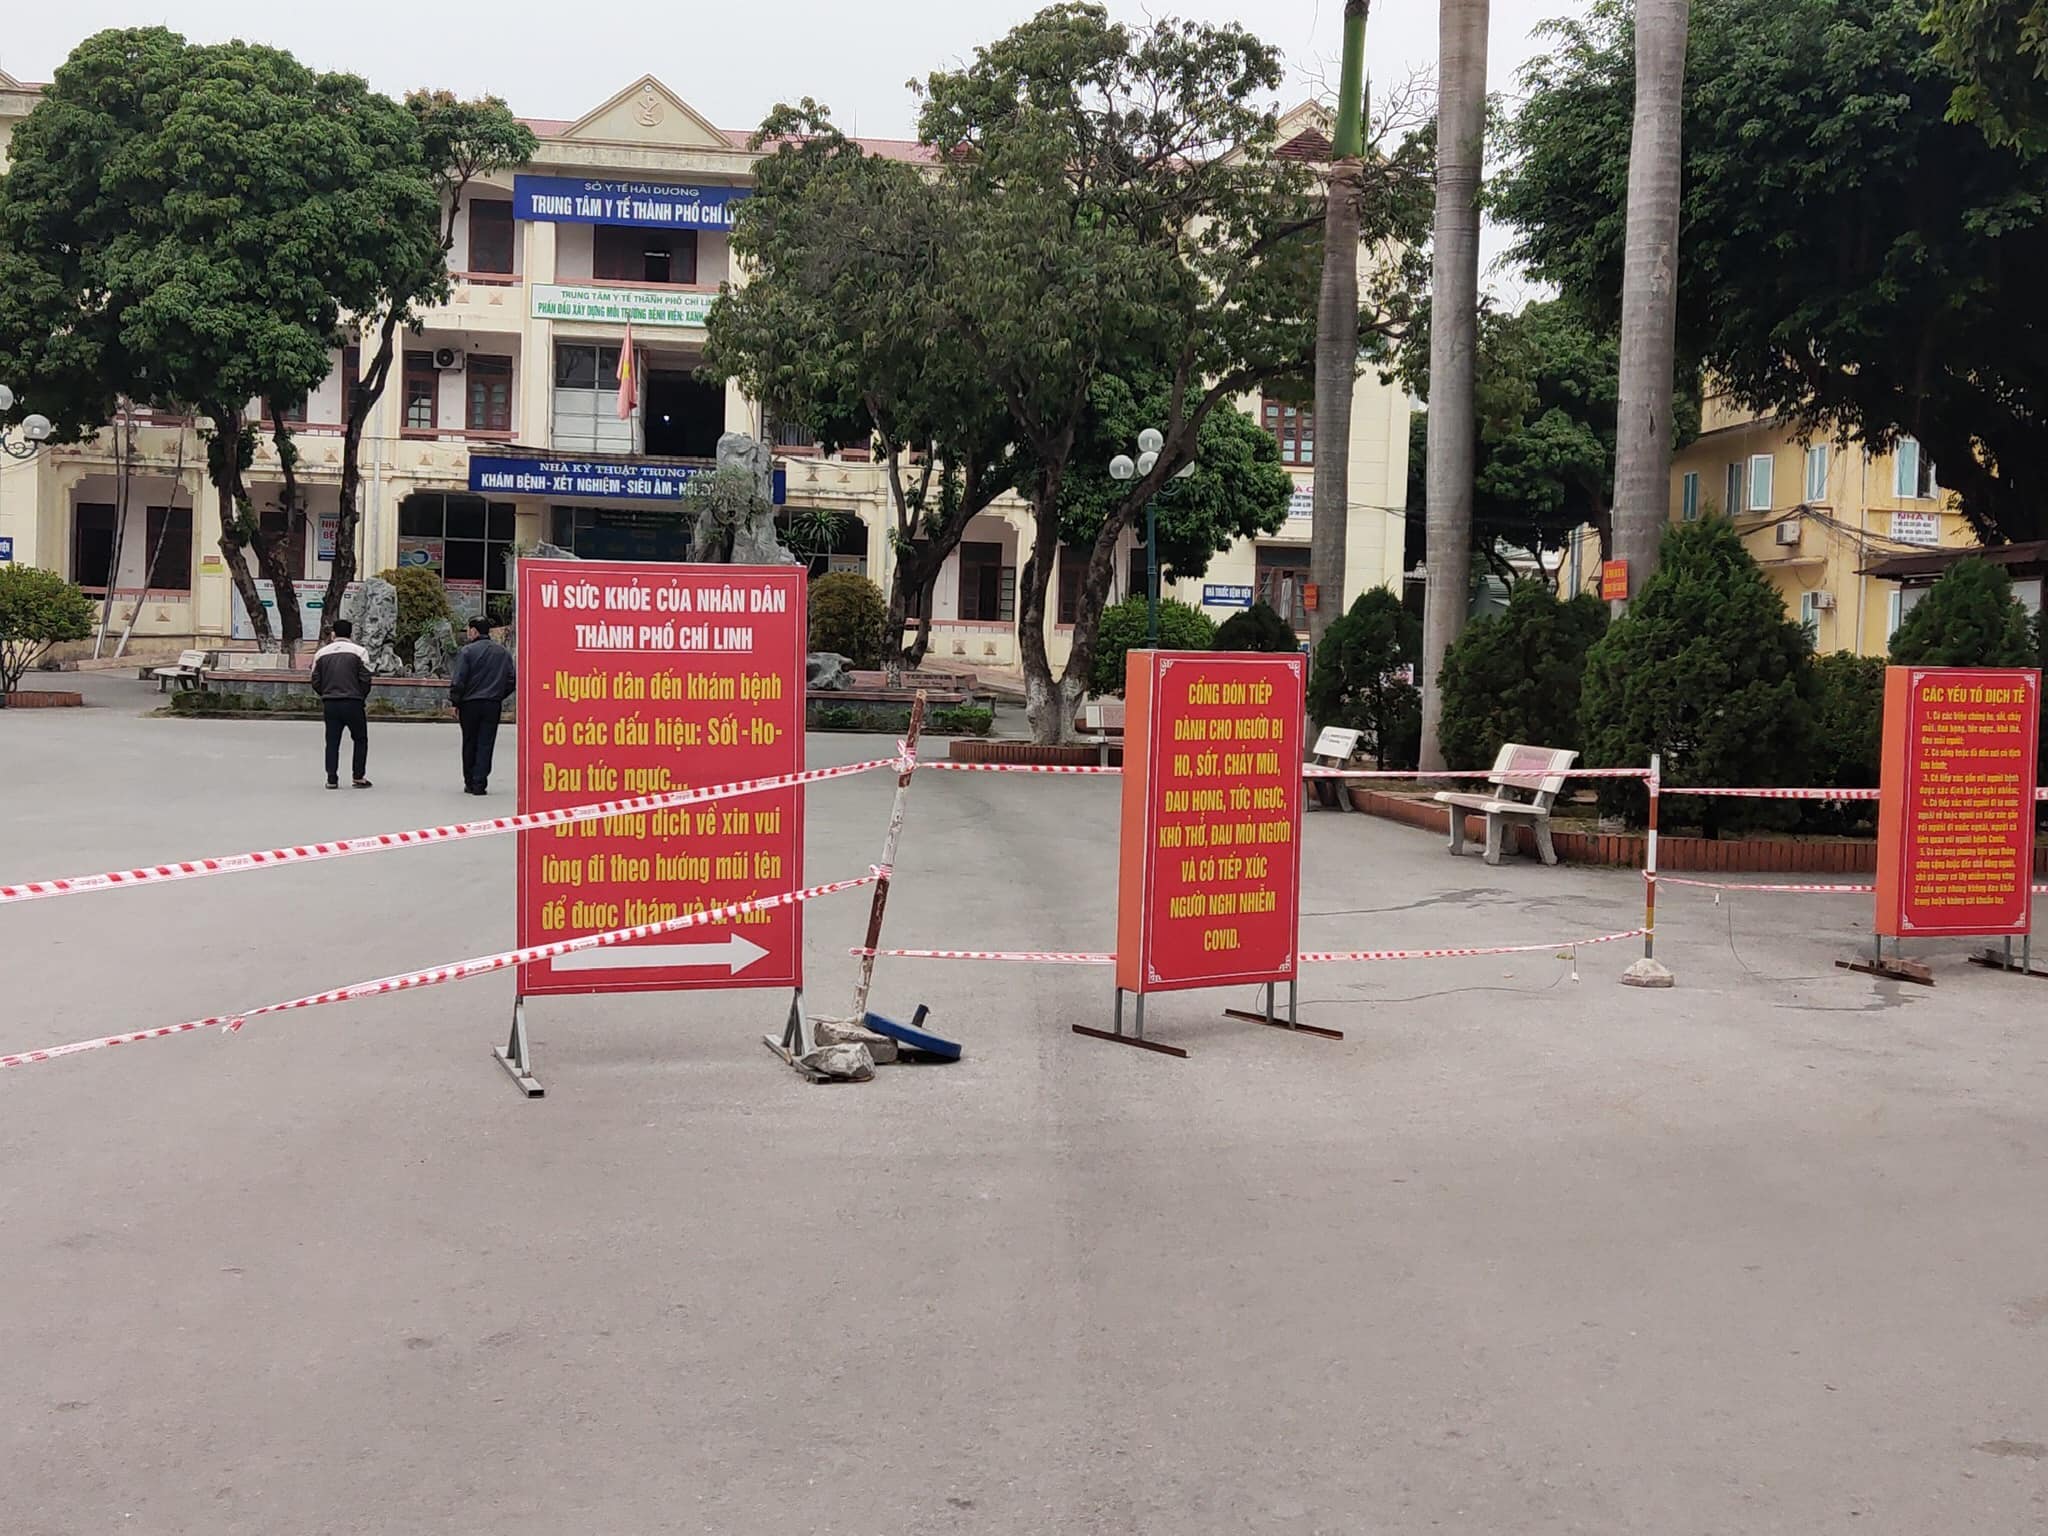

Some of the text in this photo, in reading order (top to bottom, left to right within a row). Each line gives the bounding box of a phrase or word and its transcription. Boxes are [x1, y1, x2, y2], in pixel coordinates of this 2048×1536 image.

[585, 181, 700, 197] SỞ Y TẾ HẢI DƯƠNG
[531, 194, 747, 225] TRUNG TÂM Y TẾ THÀNH PHỐ CHÍ LI
[561, 291, 590, 300] TRUNG
[592, 290, 611, 301] TÂM
[613, 294, 621, 302] Y
[622, 292, 632, 303] TẾ
[634, 294, 663, 305] THÀNH
[664, 295, 682, 305] PHỐ
[481, 471, 514, 489] KHÁM
[516, 473, 546, 491] BỆNH
[553, 474, 573, 491] XÉT
[576, 476, 620, 495] NGHIỆM
[627, 478, 652, 495] SIÊU
[654, 478, 672, 496] ÂM
[540, 462, 570, 473] NHÀ
[572, 463, 592, 474] KỸ
[595, 464, 638, 477] THUẬT
[641, 467, 686, 478] TRUNG
[541, 577, 786, 613] VÌ SỨC KHỎE CỦA NHÂN DÂN
[575, 618, 753, 651] THÀNH PHỐ CHÍ LINH
[555, 667, 607, 703] Người
[613, 670, 645, 700] dân
[650, 667, 682, 700] đến
[687, 671, 735, 700] khám
[740, 672, 782, 706] bệnh
[1188, 675, 1273, 705] CỔNG ĐÓN TIẾP
[1922, 685, 1945, 702] CÁC
[1947, 683, 1967, 703] YẾU
[1970, 683, 1984, 703] TỐ
[1986, 688, 2010, 706] DỊCH
[542, 715, 566, 746] có
[572, 716, 608, 746] các
[614, 710, 649, 746] dấu
[654, 716, 702, 752] hiệu:
[707, 712, 739, 746] Sốt
[1174, 713, 1284, 744] DÀNH CHO NGƯỜI BỊ
[543, 759, 689, 796] Đau tức ngực...
[1174, 744, 1281, 779] HO, SỐT, CHẢY MŨI,
[1165, 783, 1287, 816] ĐAU HỌNG, TỨC NGỰC,
[652, 808, 691, 842] dịch
[696, 801, 717, 836] về
[722, 807, 750, 835] xin
[754, 806, 781, 835] vui
[1159, 812, 1291, 849] KHÓ THỞ, ĐAU MỎI NGƯỜI
[542, 850, 781, 887] lòng đi theo hướng mũi tên
[1181, 851, 1268, 883] VÀ CÓ TIẾP XÚC
[542, 894, 567, 930] để
[572, 899, 619, 934] được
[624, 898, 677, 928] khám
[1170, 884, 1276, 919] NGƯỜI NGHI NHIỄM
[1204, 928, 1240, 951] COVID.
